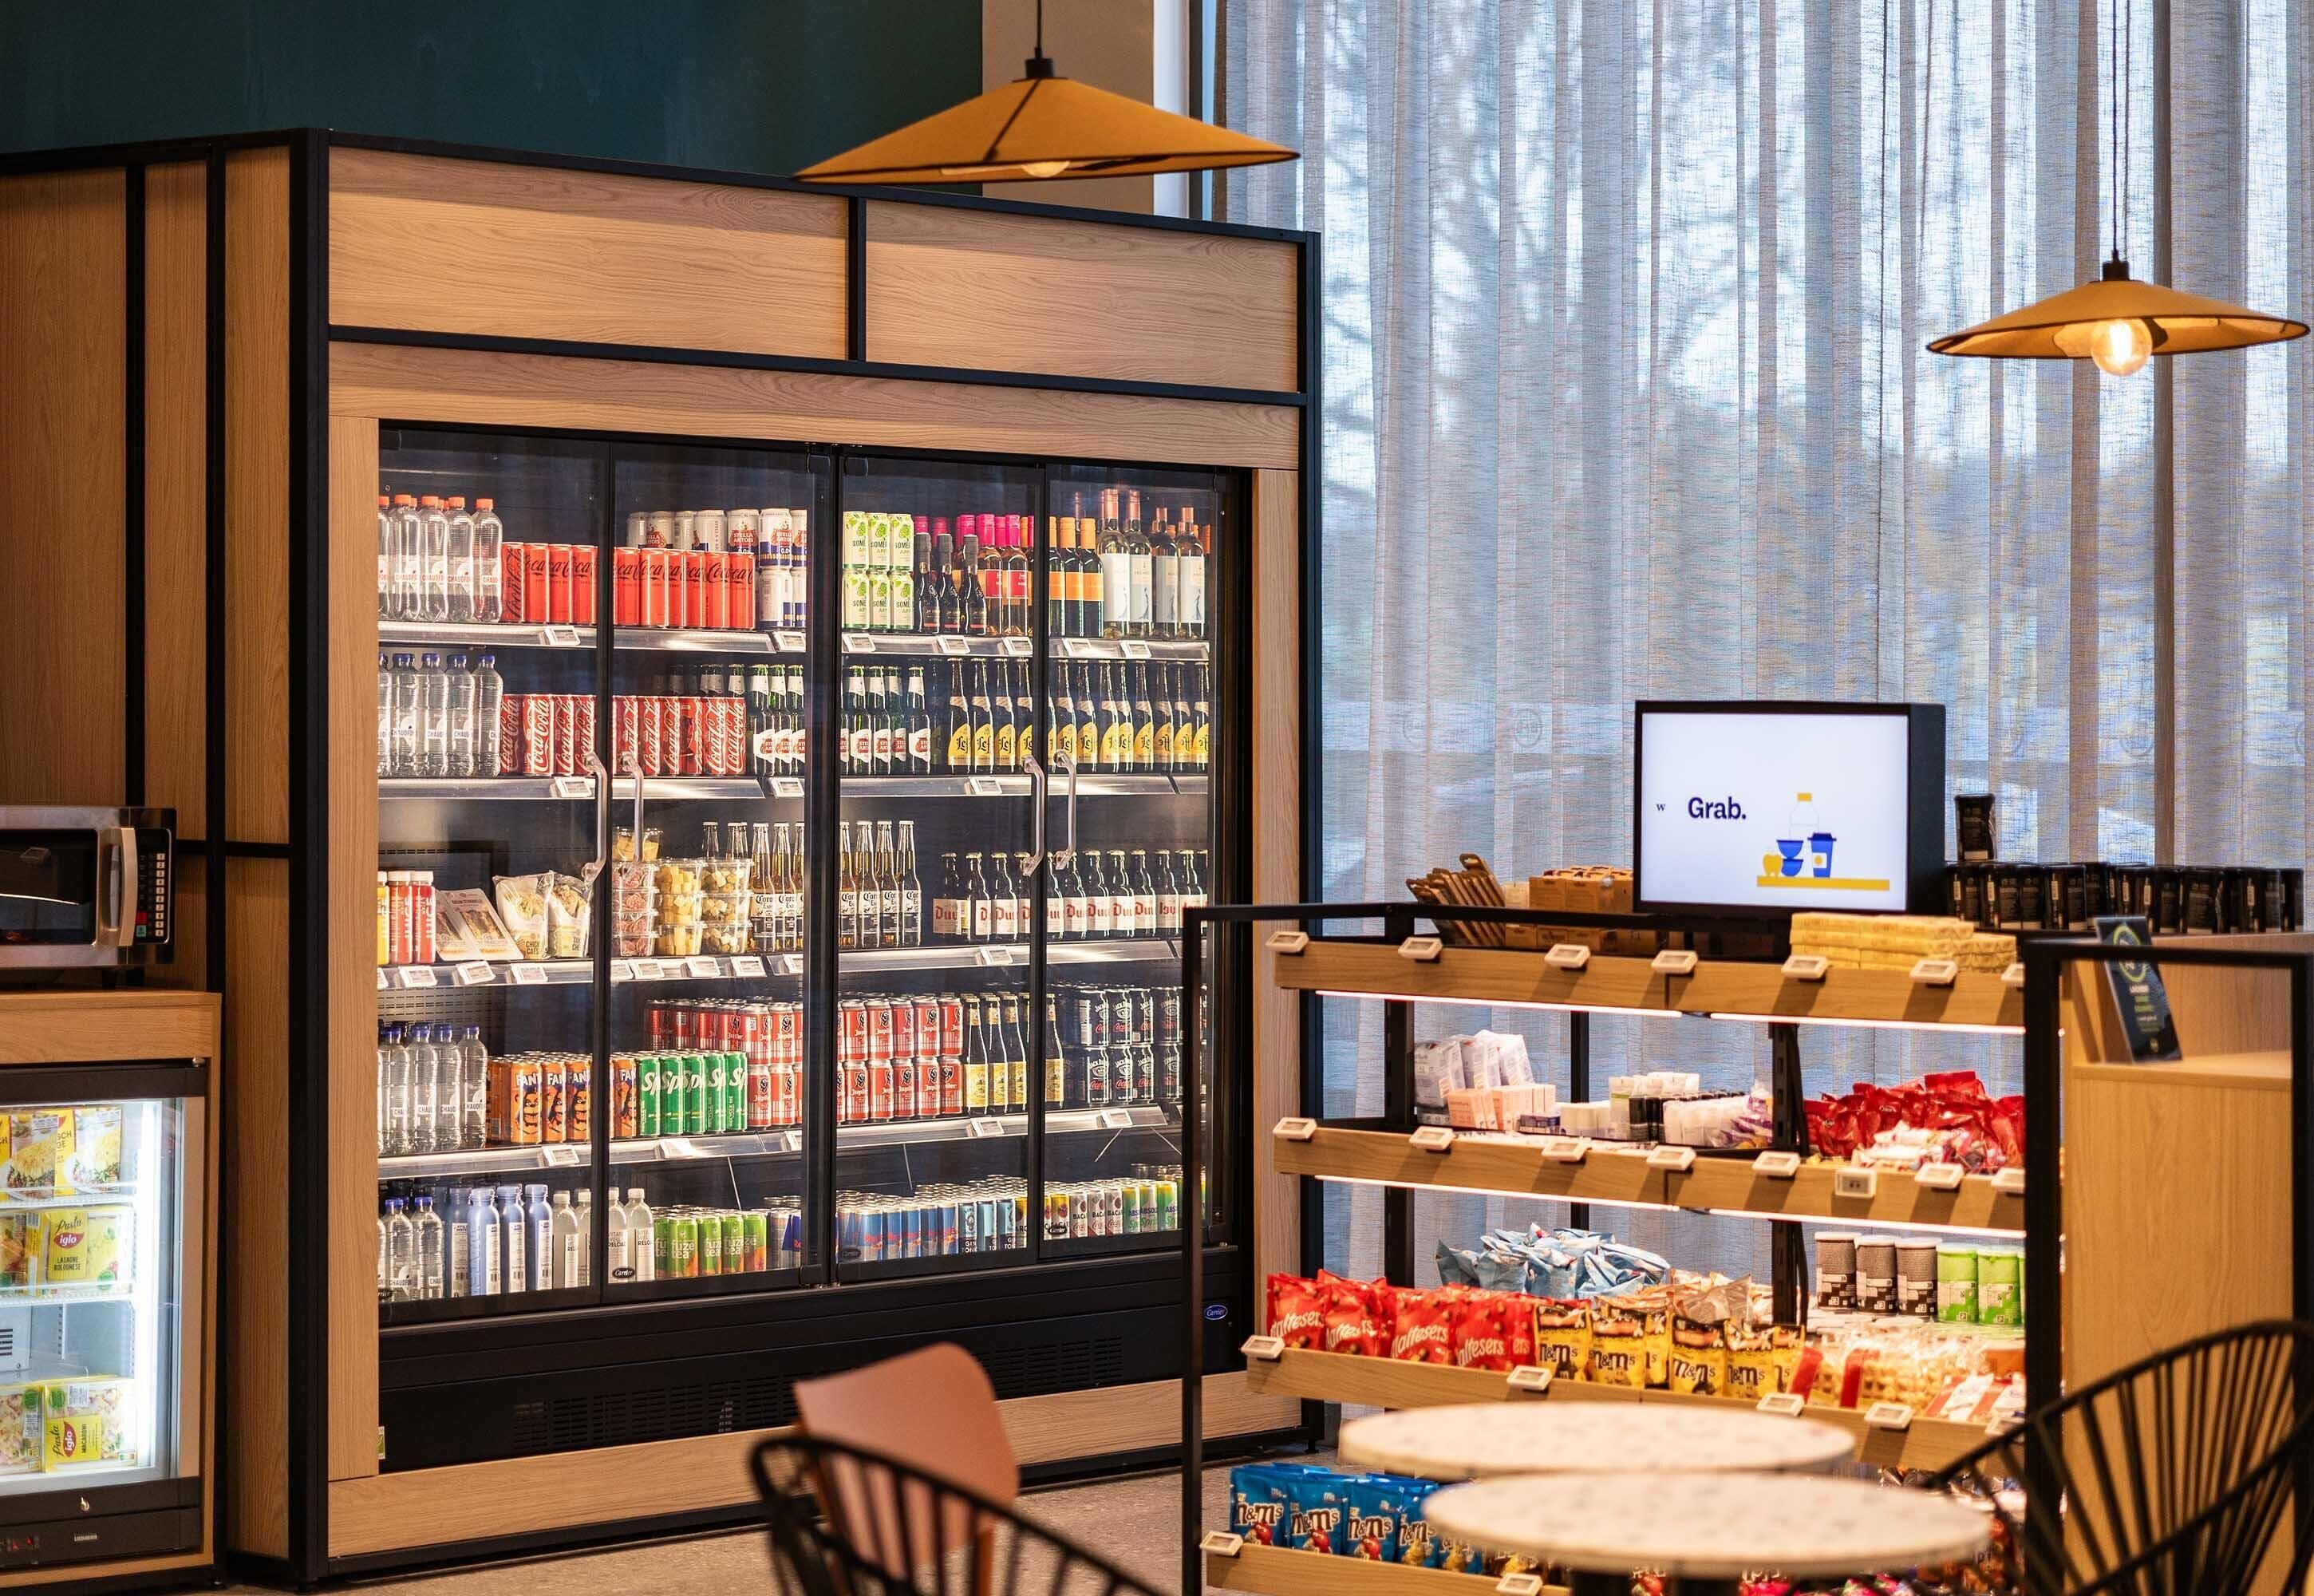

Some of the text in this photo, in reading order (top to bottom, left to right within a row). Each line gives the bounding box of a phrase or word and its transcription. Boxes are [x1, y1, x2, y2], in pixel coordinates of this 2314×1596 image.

[1688, 796, 1747, 820] Grab.
[57, 1215, 83, 1235] Pasta
[59, 1234, 77, 1246] iglo
[671, 1239, 695, 1251] fuze
[671, 1250, 691, 1259] tea
[51, 1424, 64, 1457] Pasta
[65, 1431, 75, 1451] iglo
